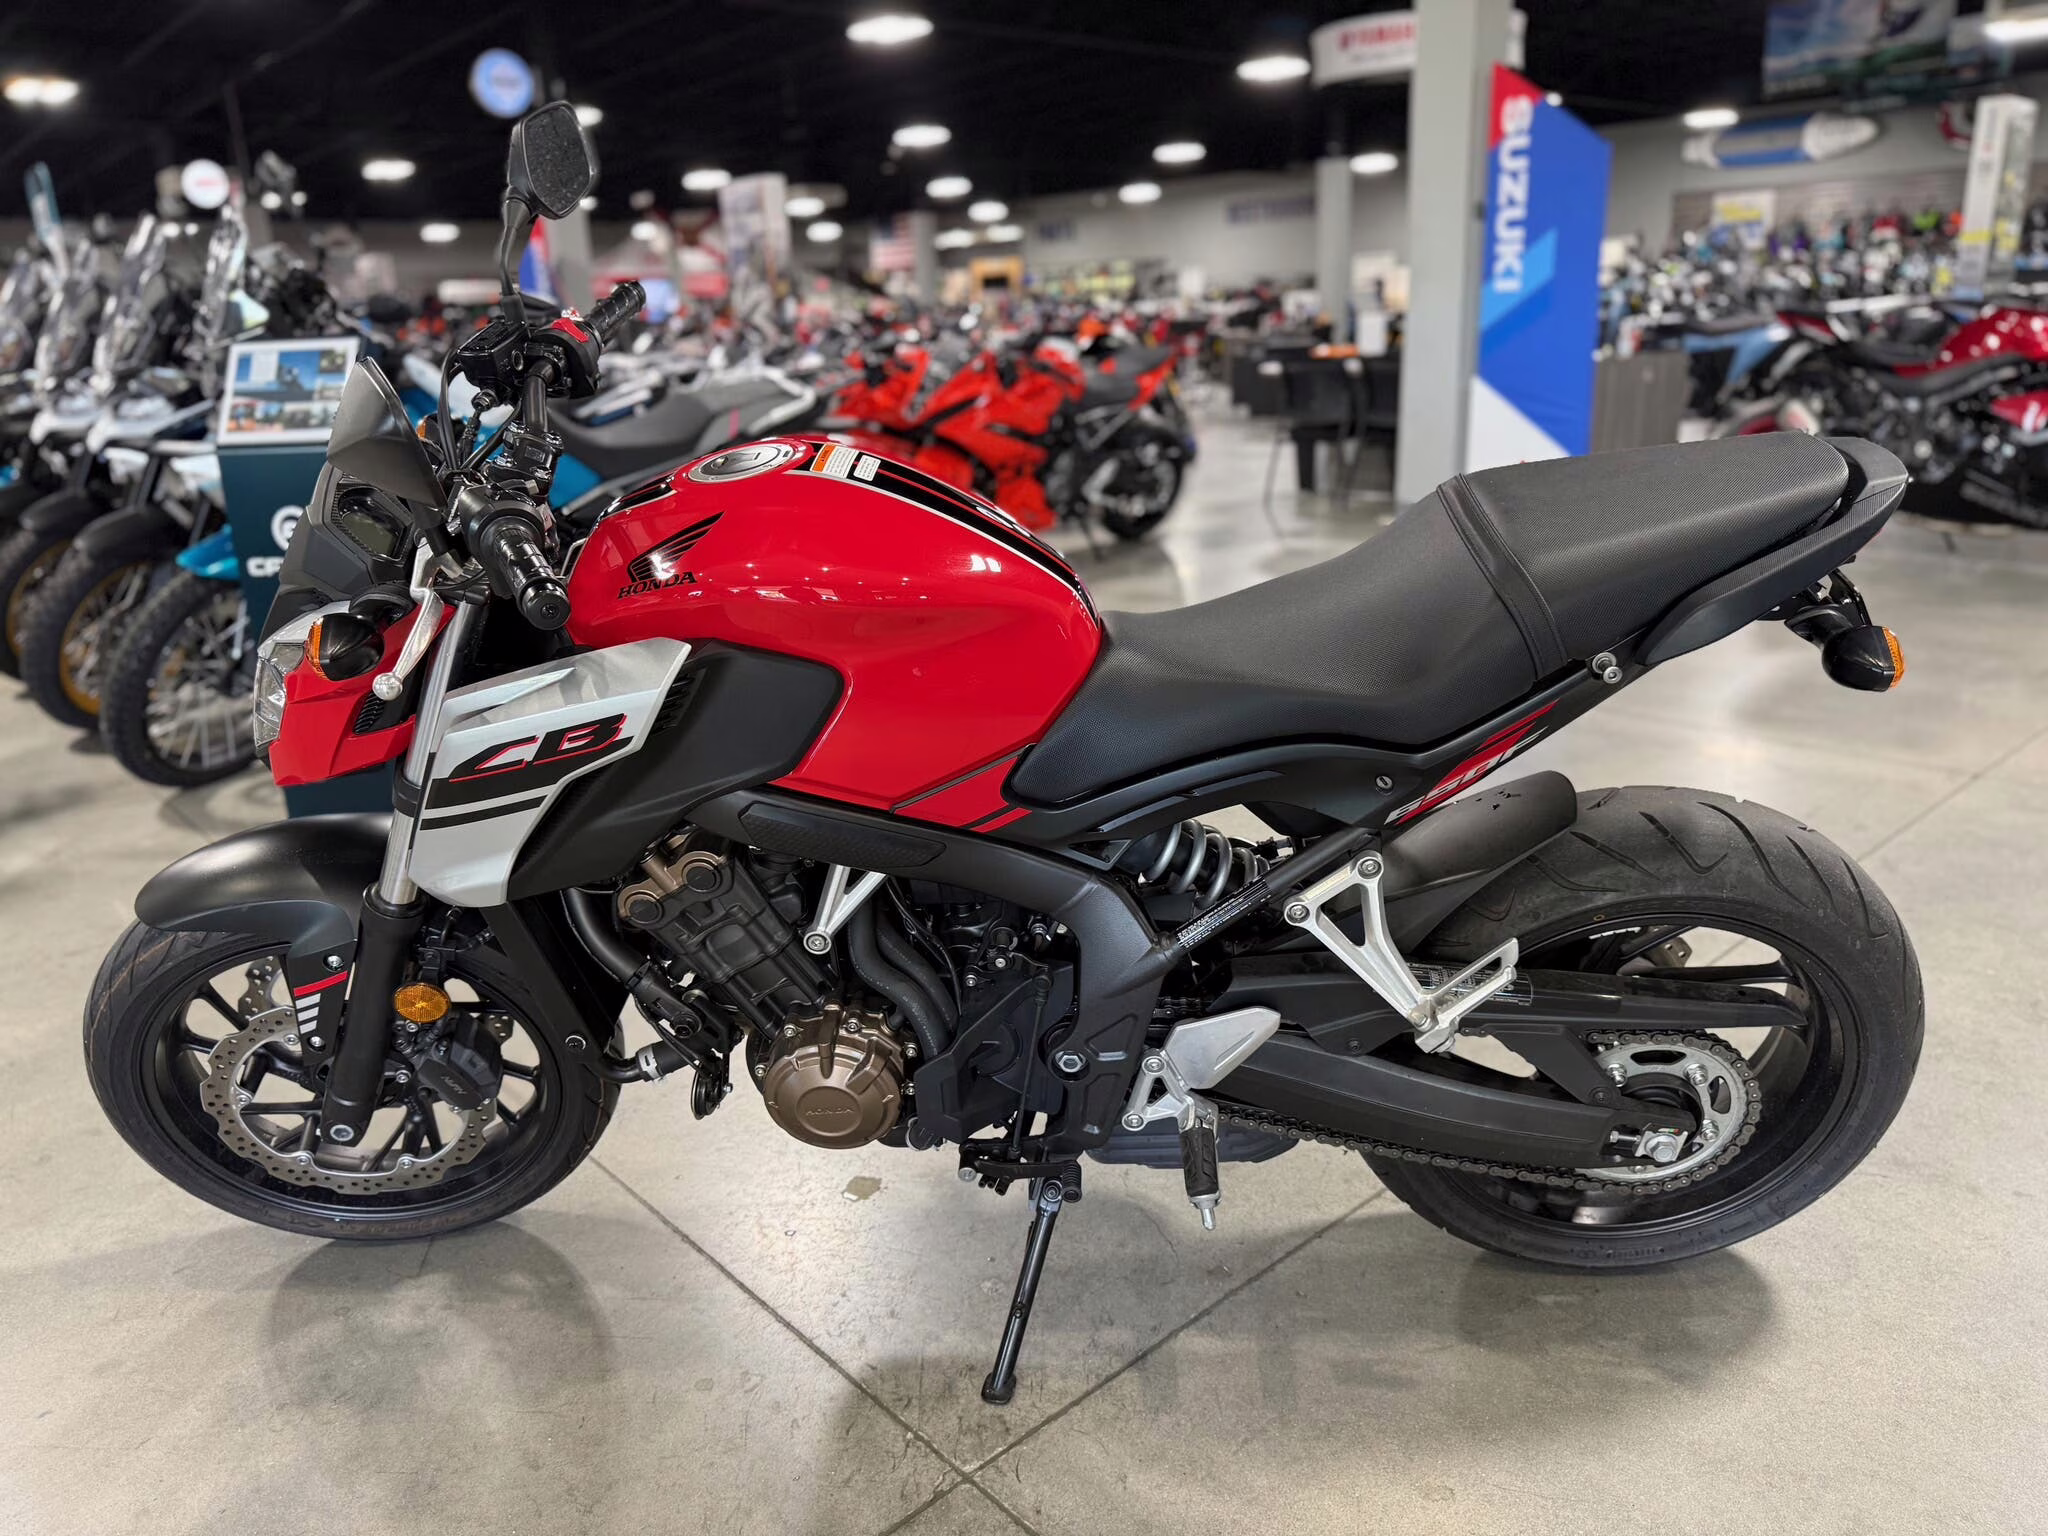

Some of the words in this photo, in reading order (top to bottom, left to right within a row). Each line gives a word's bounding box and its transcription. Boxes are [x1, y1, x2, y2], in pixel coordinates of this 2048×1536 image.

[1492, 95, 1534, 293] SUZUKI
[617, 571, 698, 600] HONDA
[449, 712, 628, 783] CB
[1383, 725, 1550, 825] 650F
